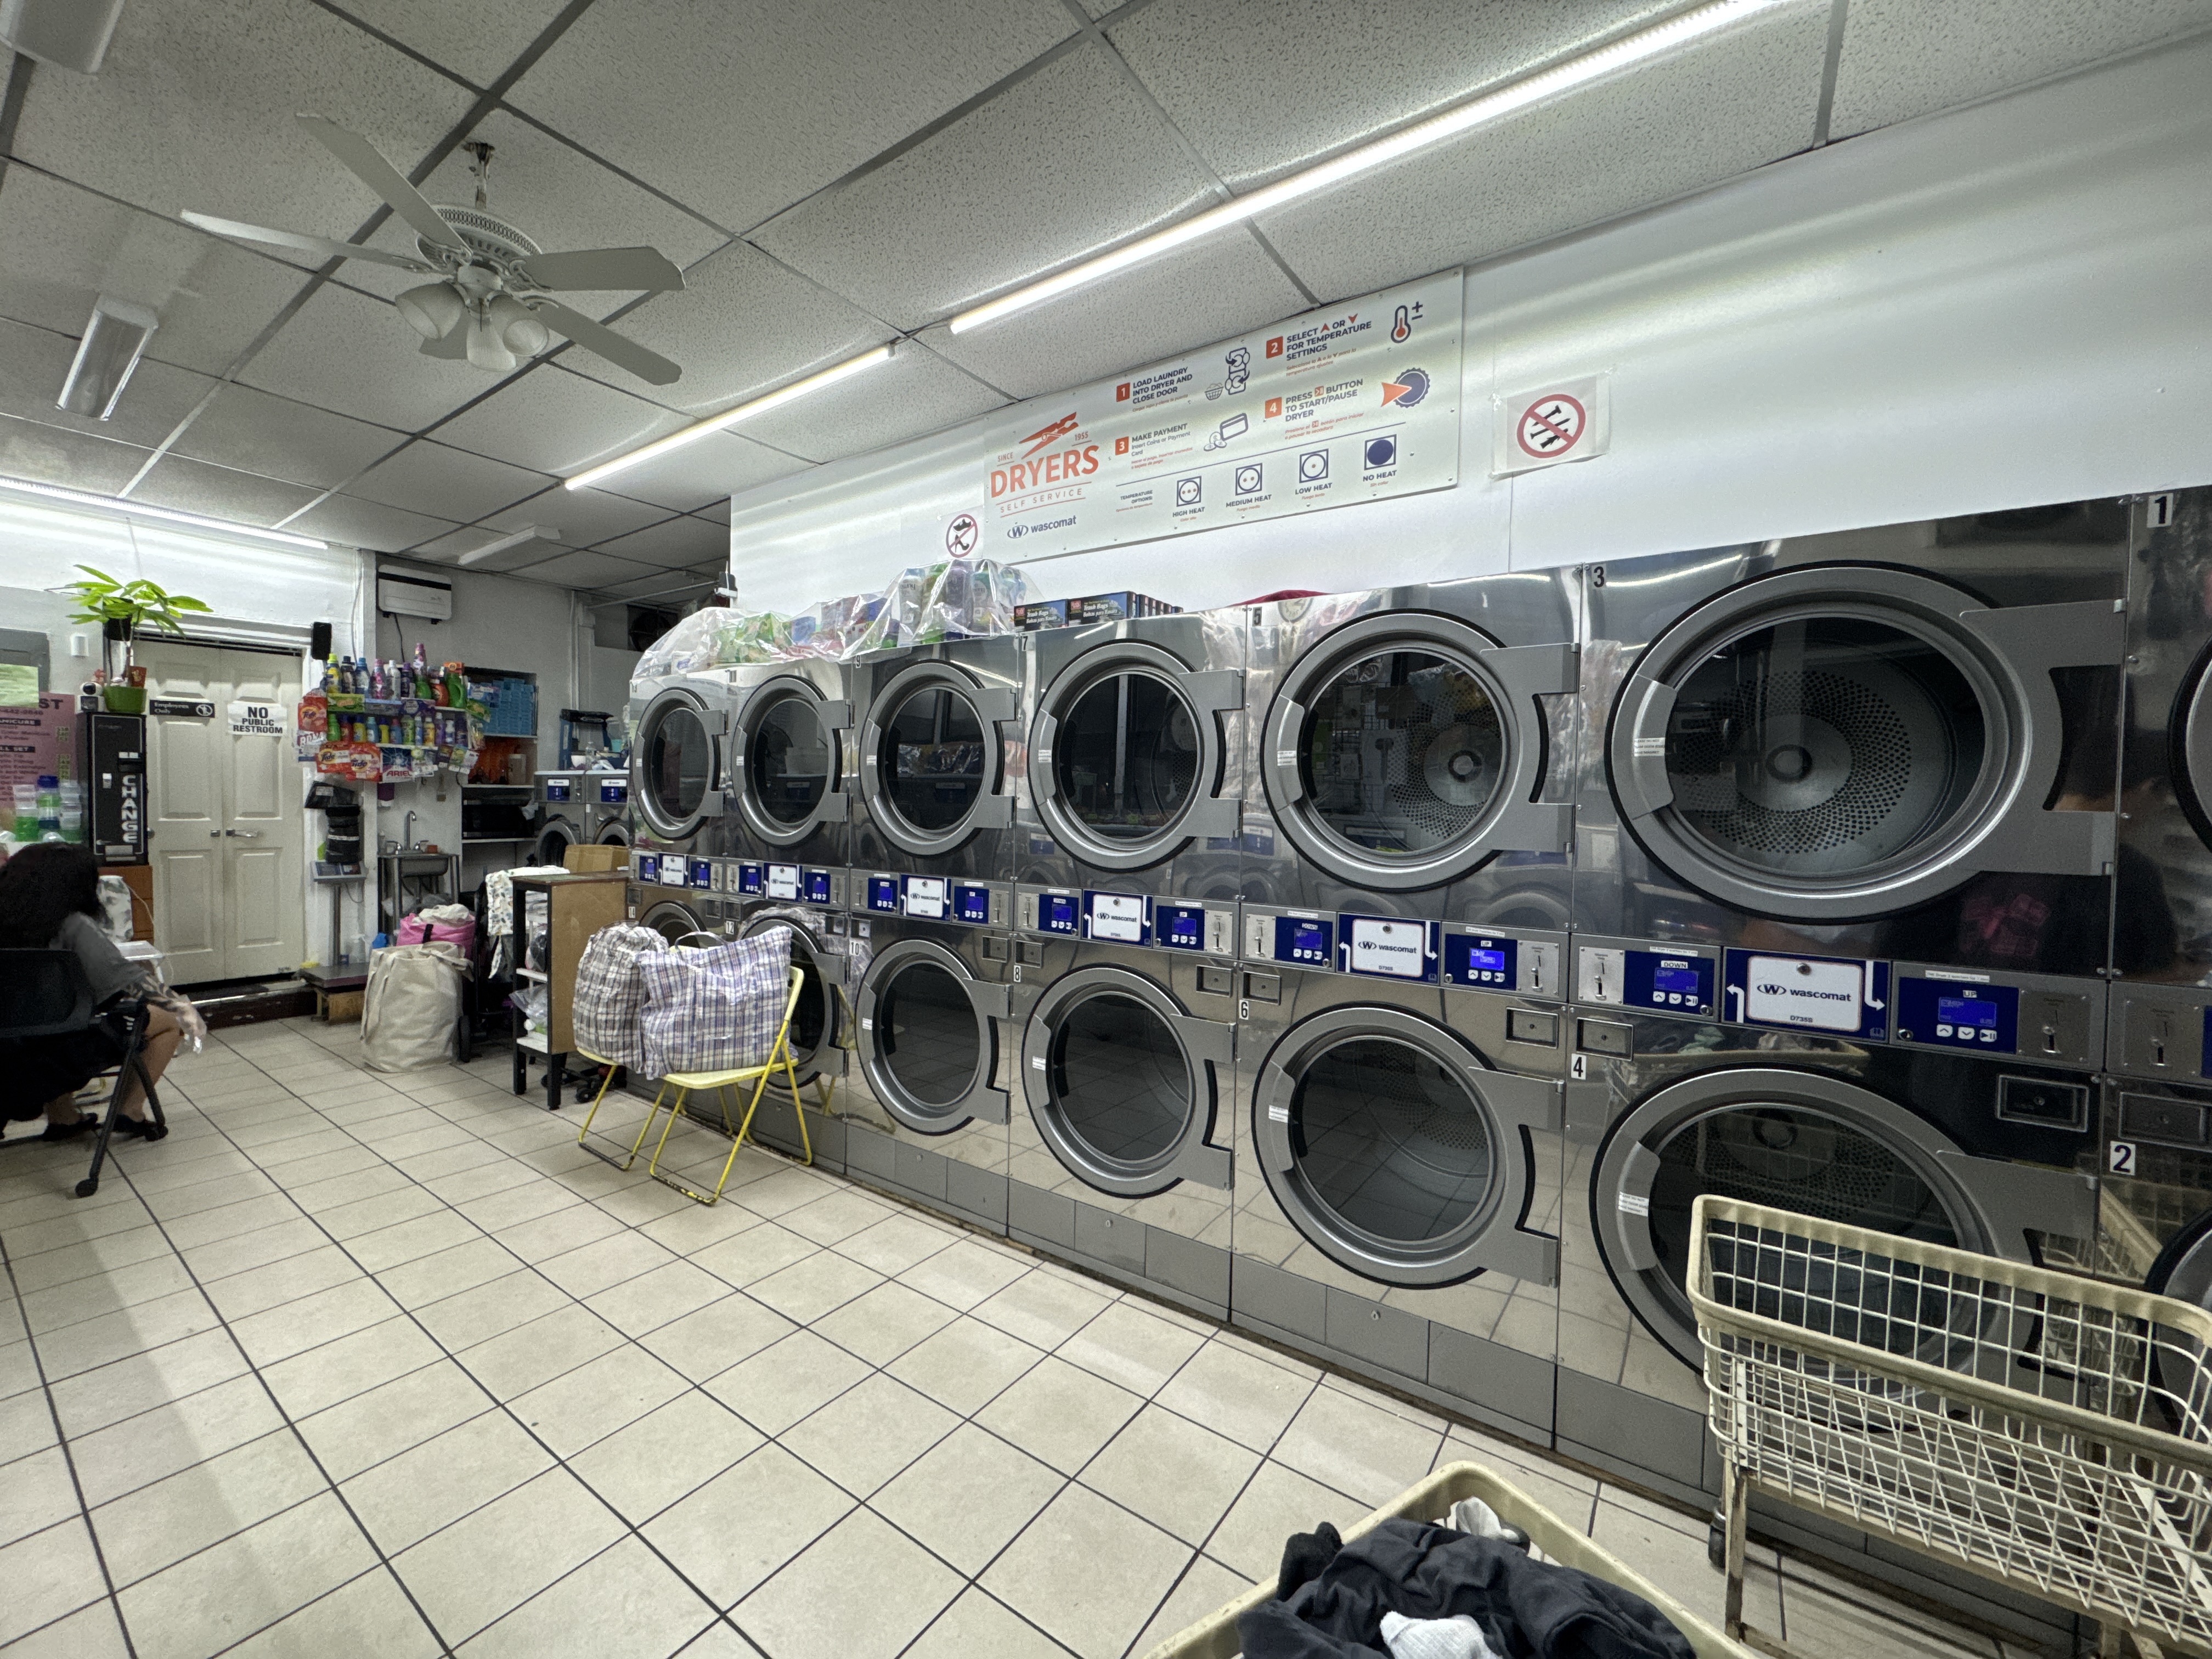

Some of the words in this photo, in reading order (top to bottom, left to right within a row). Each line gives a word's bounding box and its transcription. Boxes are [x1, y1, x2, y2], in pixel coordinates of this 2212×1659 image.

[1287, 328, 1318, 343] SELECT
[1333, 320, 1346, 329] OR
[1287, 342, 1304, 352] FOR
[1306, 321, 1372, 346] TEMPERATURE
[1271, 342, 1278, 353] 2
[1286, 343, 1327, 360] SETTINGS
[1133, 378, 1152, 388] LOAD
[1154, 366, 1188, 382] LAUNDRY
[1133, 387, 1149, 396] INTO
[1151, 380, 1175, 391] DRYER
[1176, 374, 1193, 385] AND
[1286, 392, 1312, 404] PRESS
[1326, 379, 1363, 394] BUTTON
[1121, 387, 1125, 397] 1
[1132, 393, 1155, 404] CLOSE
[1156, 386, 1177, 397] DOOR
[1269, 402, 1277, 413] 4
[1285, 405, 1297, 413] TO
[1299, 390, 1358, 410] START/PAUSE
[1285, 409, 1314, 422] DRYER
[1075, 431, 1088, 441] 1955
[1132, 432, 1152, 443] MAKE
[1154, 423, 1188, 437] PAYMENT
[1168, 431, 1190, 441] Payment
[1119, 441, 1125, 451] 3
[997, 452, 1013, 462] SINCE
[991, 445, 1099, 498] DRYERS
[1376, 470, 1397, 479] HEAT
[1120, 490, 1153, 500] TEMPERATURE
[1295, 487, 1312, 495] LOW
[1313, 483, 1332, 492] HEAT
[1000, 500, 1025, 513] SELF
[1033, 488, 1082, 503] SERVICE
[1226, 498, 1253, 507] MEDIUM
[1255, 494, 1272, 503] HEAT
[1172, 509, 1187, 517] HIGH
[1189, 507, 1205, 515] HEAT
[2154, 496, 2167, 524] 1
[1031, 515, 1076, 533] wascomat
[1594, 566, 1604, 588] 3
[1254, 608, 1261, 625] 5
[1023, 636, 1028, 650] 7
[856, 655, 860, 667] 9
[38, 698, 64, 709] ST
[248, 707, 268, 719] NO
[233, 725, 283, 734] RESTROOM
[351, 759, 368, 768] Tide
[122, 775, 138, 844] CHANGE
[629, 907, 636, 918] 14
[727, 922, 734, 934] 12
[851, 942, 859, 955] 10
[1379, 944, 1417, 953] wascomat
[1015, 967, 1020, 981] 8
[1790, 989, 1852, 1002] wascomat
[1241, 1001, 1248, 1019] 6
[1573, 1056, 1583, 1078] 4
[2113, 1144, 2132, 1173] 2
